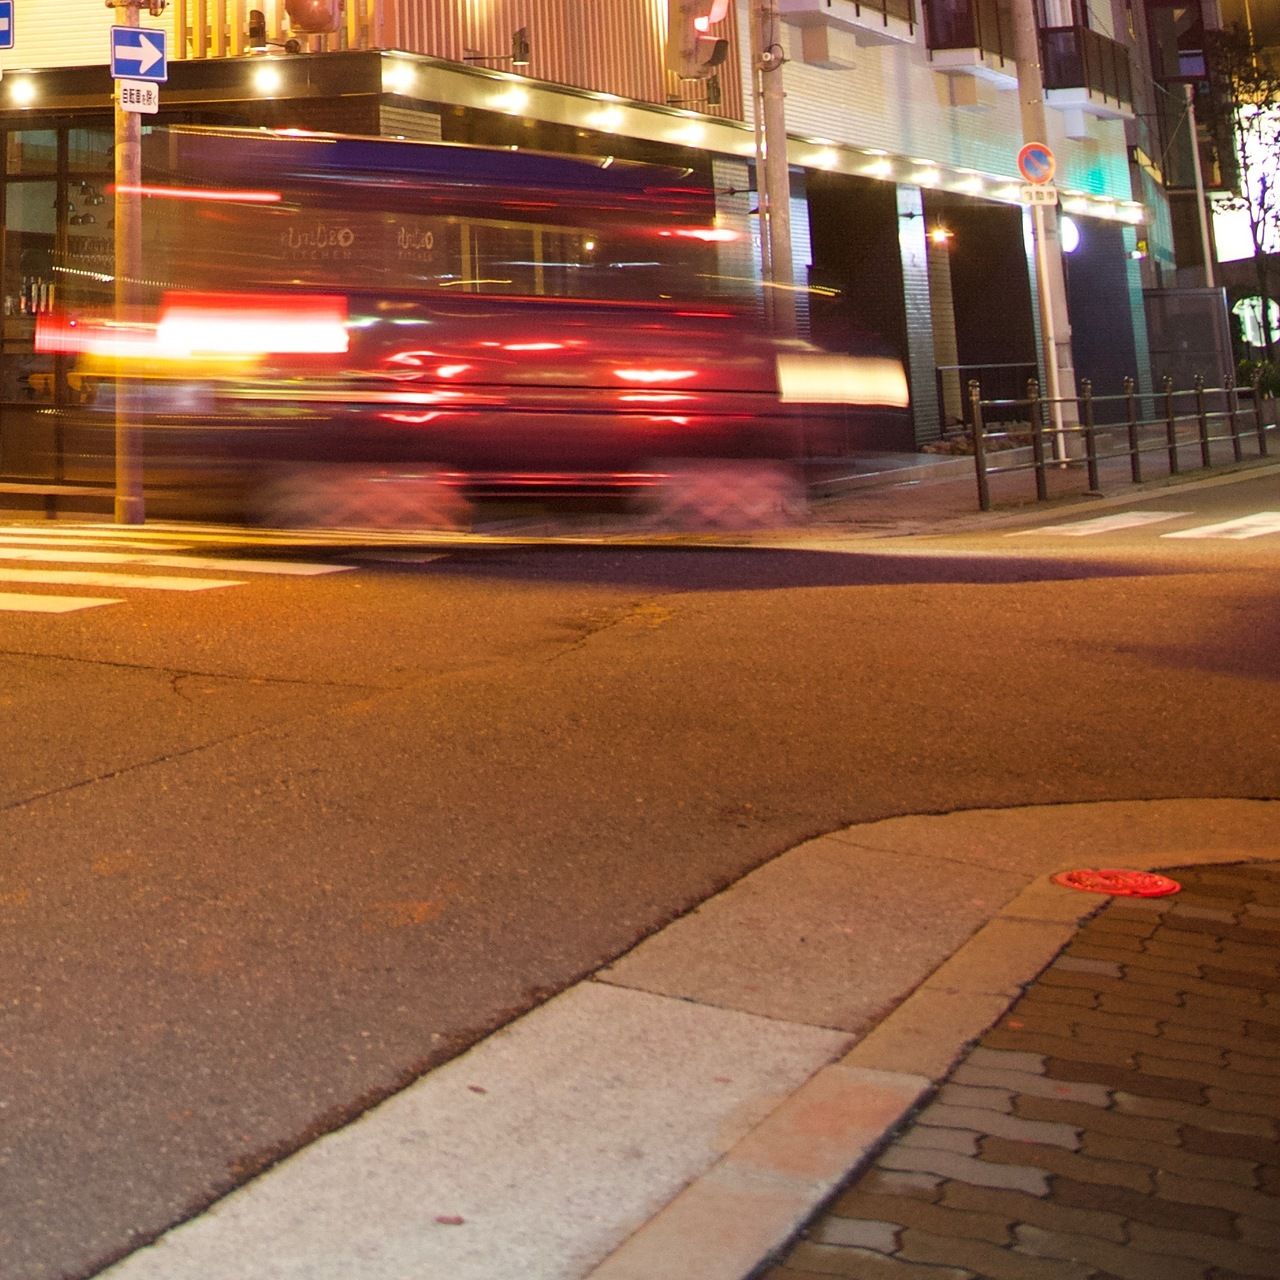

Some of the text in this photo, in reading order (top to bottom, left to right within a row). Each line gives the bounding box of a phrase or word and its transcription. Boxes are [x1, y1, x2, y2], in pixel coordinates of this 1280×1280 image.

[123, 88, 156, 106] 自転車を除く
